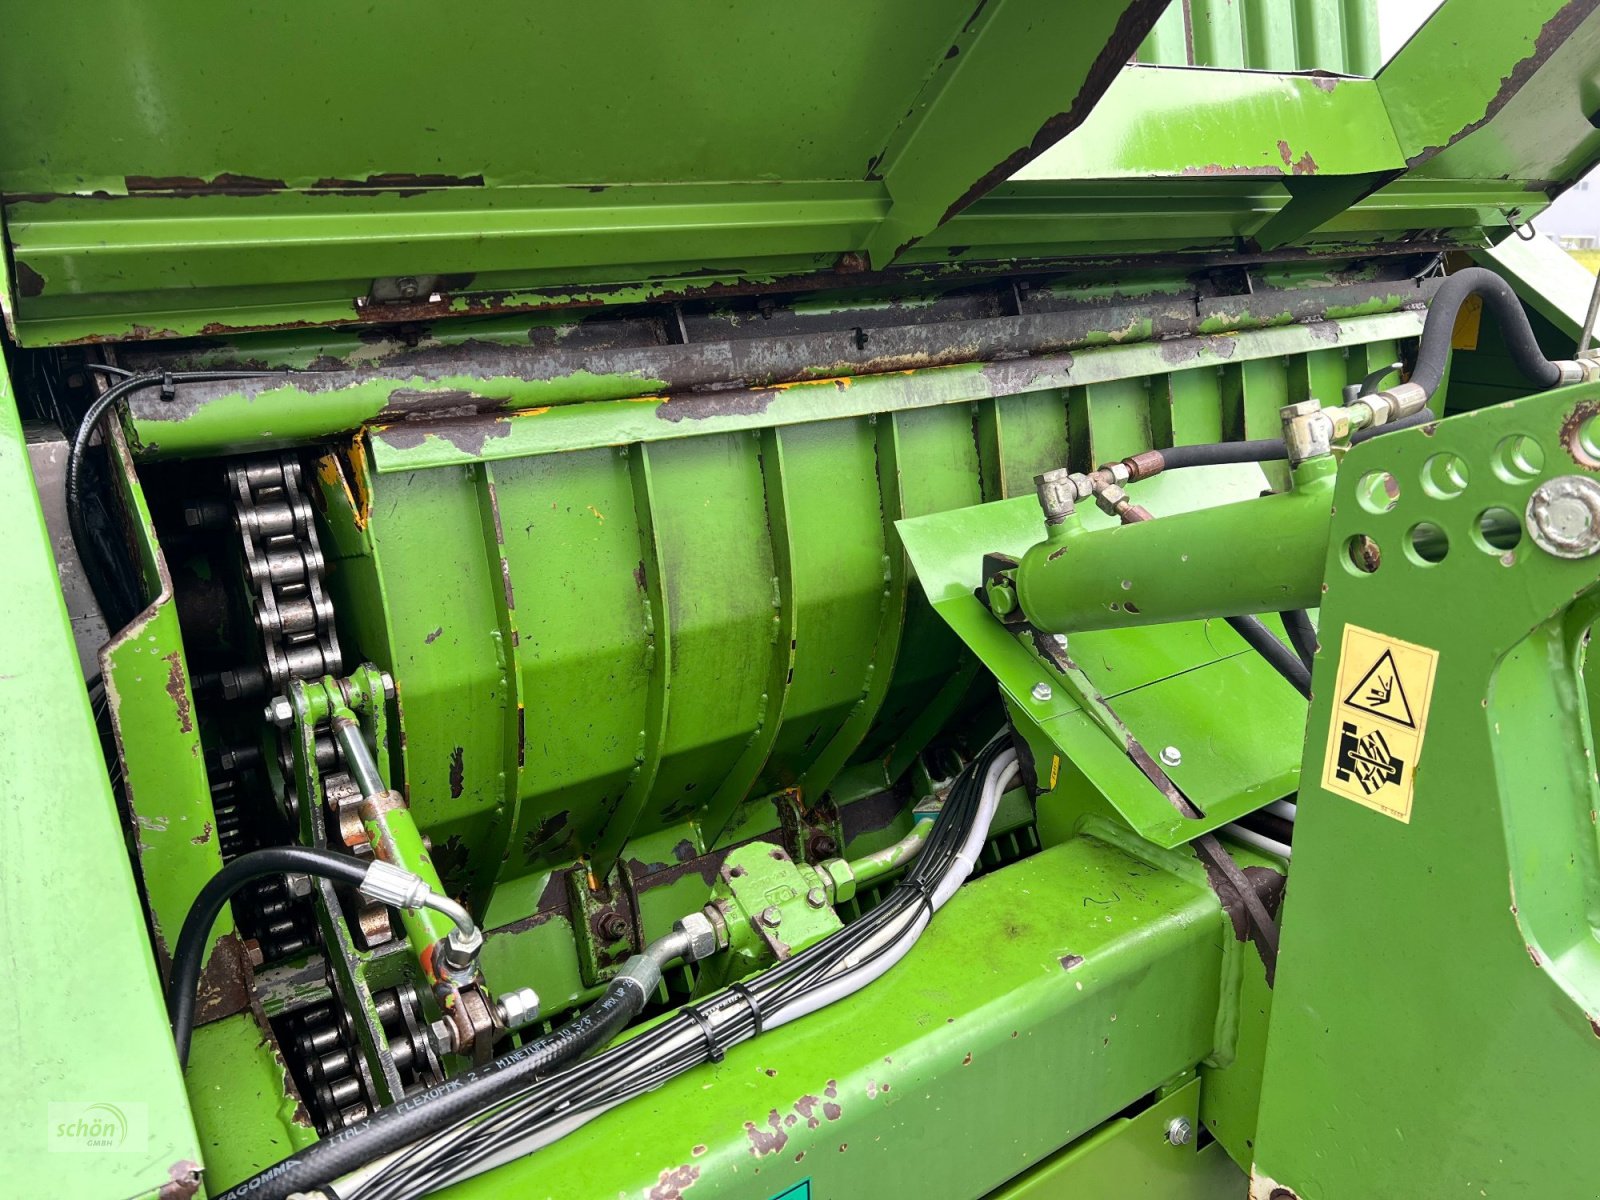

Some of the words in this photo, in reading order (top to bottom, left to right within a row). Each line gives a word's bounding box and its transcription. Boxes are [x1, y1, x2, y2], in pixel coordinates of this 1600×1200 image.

[329, 1119, 371, 1147] ITALY
[396, 1078, 463, 1114] FLEXOPAK
[467, 1072, 478, 1082] 2
[557, 1028, 571, 1039] 10
[602, 996, 619, 1010] MAX
